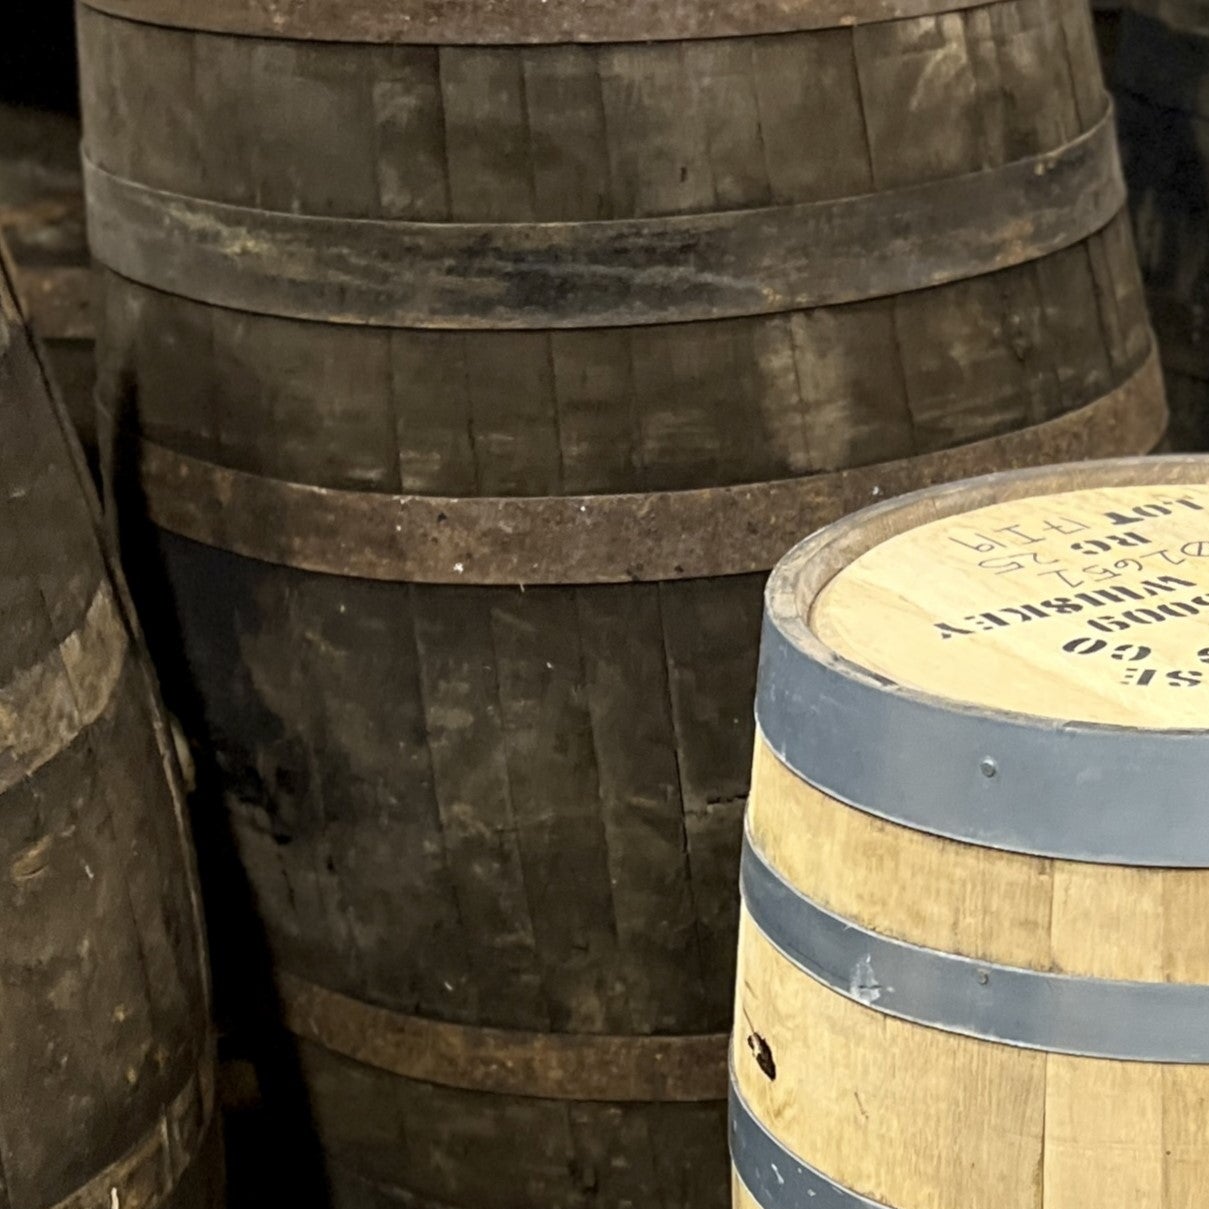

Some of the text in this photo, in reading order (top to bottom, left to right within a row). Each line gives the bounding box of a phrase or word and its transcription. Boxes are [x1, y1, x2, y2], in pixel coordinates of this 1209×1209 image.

[1103, 496, 1204, 526] LOT
[978, 551, 1060, 575] 25
[934, 574, 1198, 639] WHISKEY
[1062, 636, 1152, 662] CO
